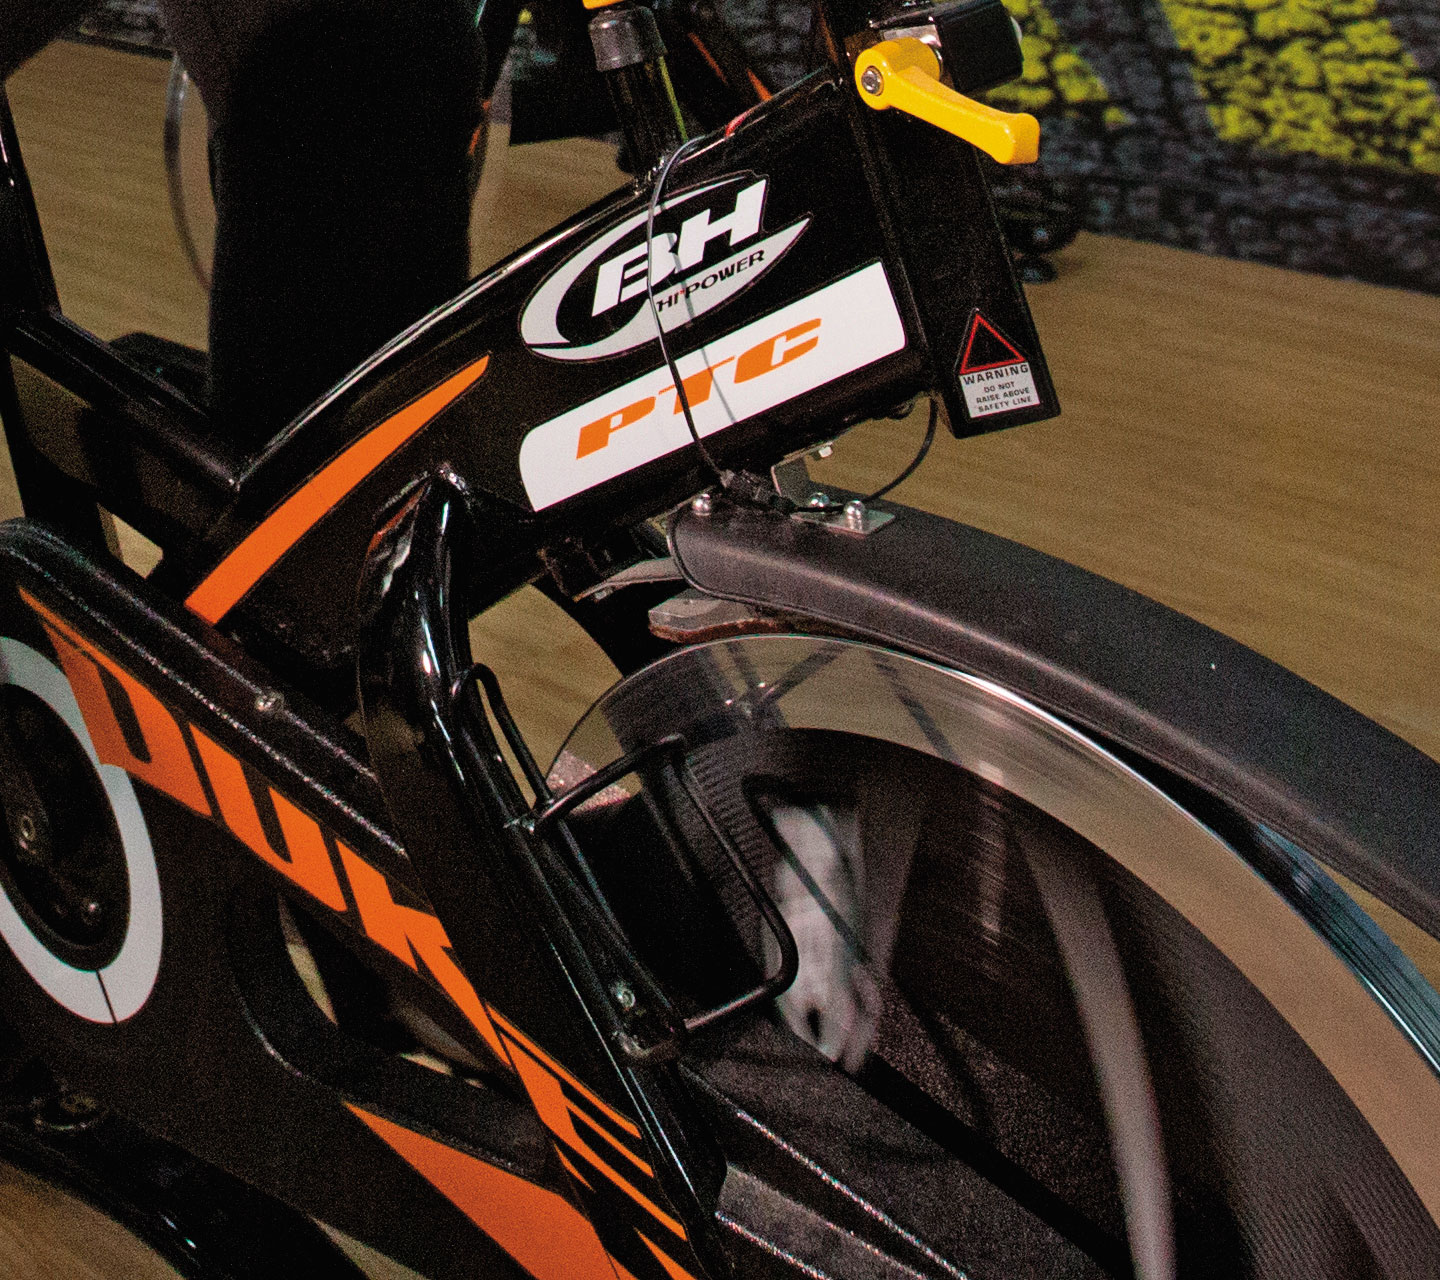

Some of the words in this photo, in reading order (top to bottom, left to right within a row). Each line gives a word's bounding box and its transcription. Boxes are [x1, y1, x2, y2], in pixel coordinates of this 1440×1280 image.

[592, 179, 767, 317] BH
[963, 364, 1029, 384] WARNING
[575, 318, 822, 460] PTC
[976, 394, 1000, 404] RAISE
[1003, 387, 1030, 398] ABOVE
[983, 385, 996, 393] DO
[997, 381, 1015, 390] NOT
[978, 401, 1010, 412] SAFETY
[1012, 396, 1032, 405] LINE
